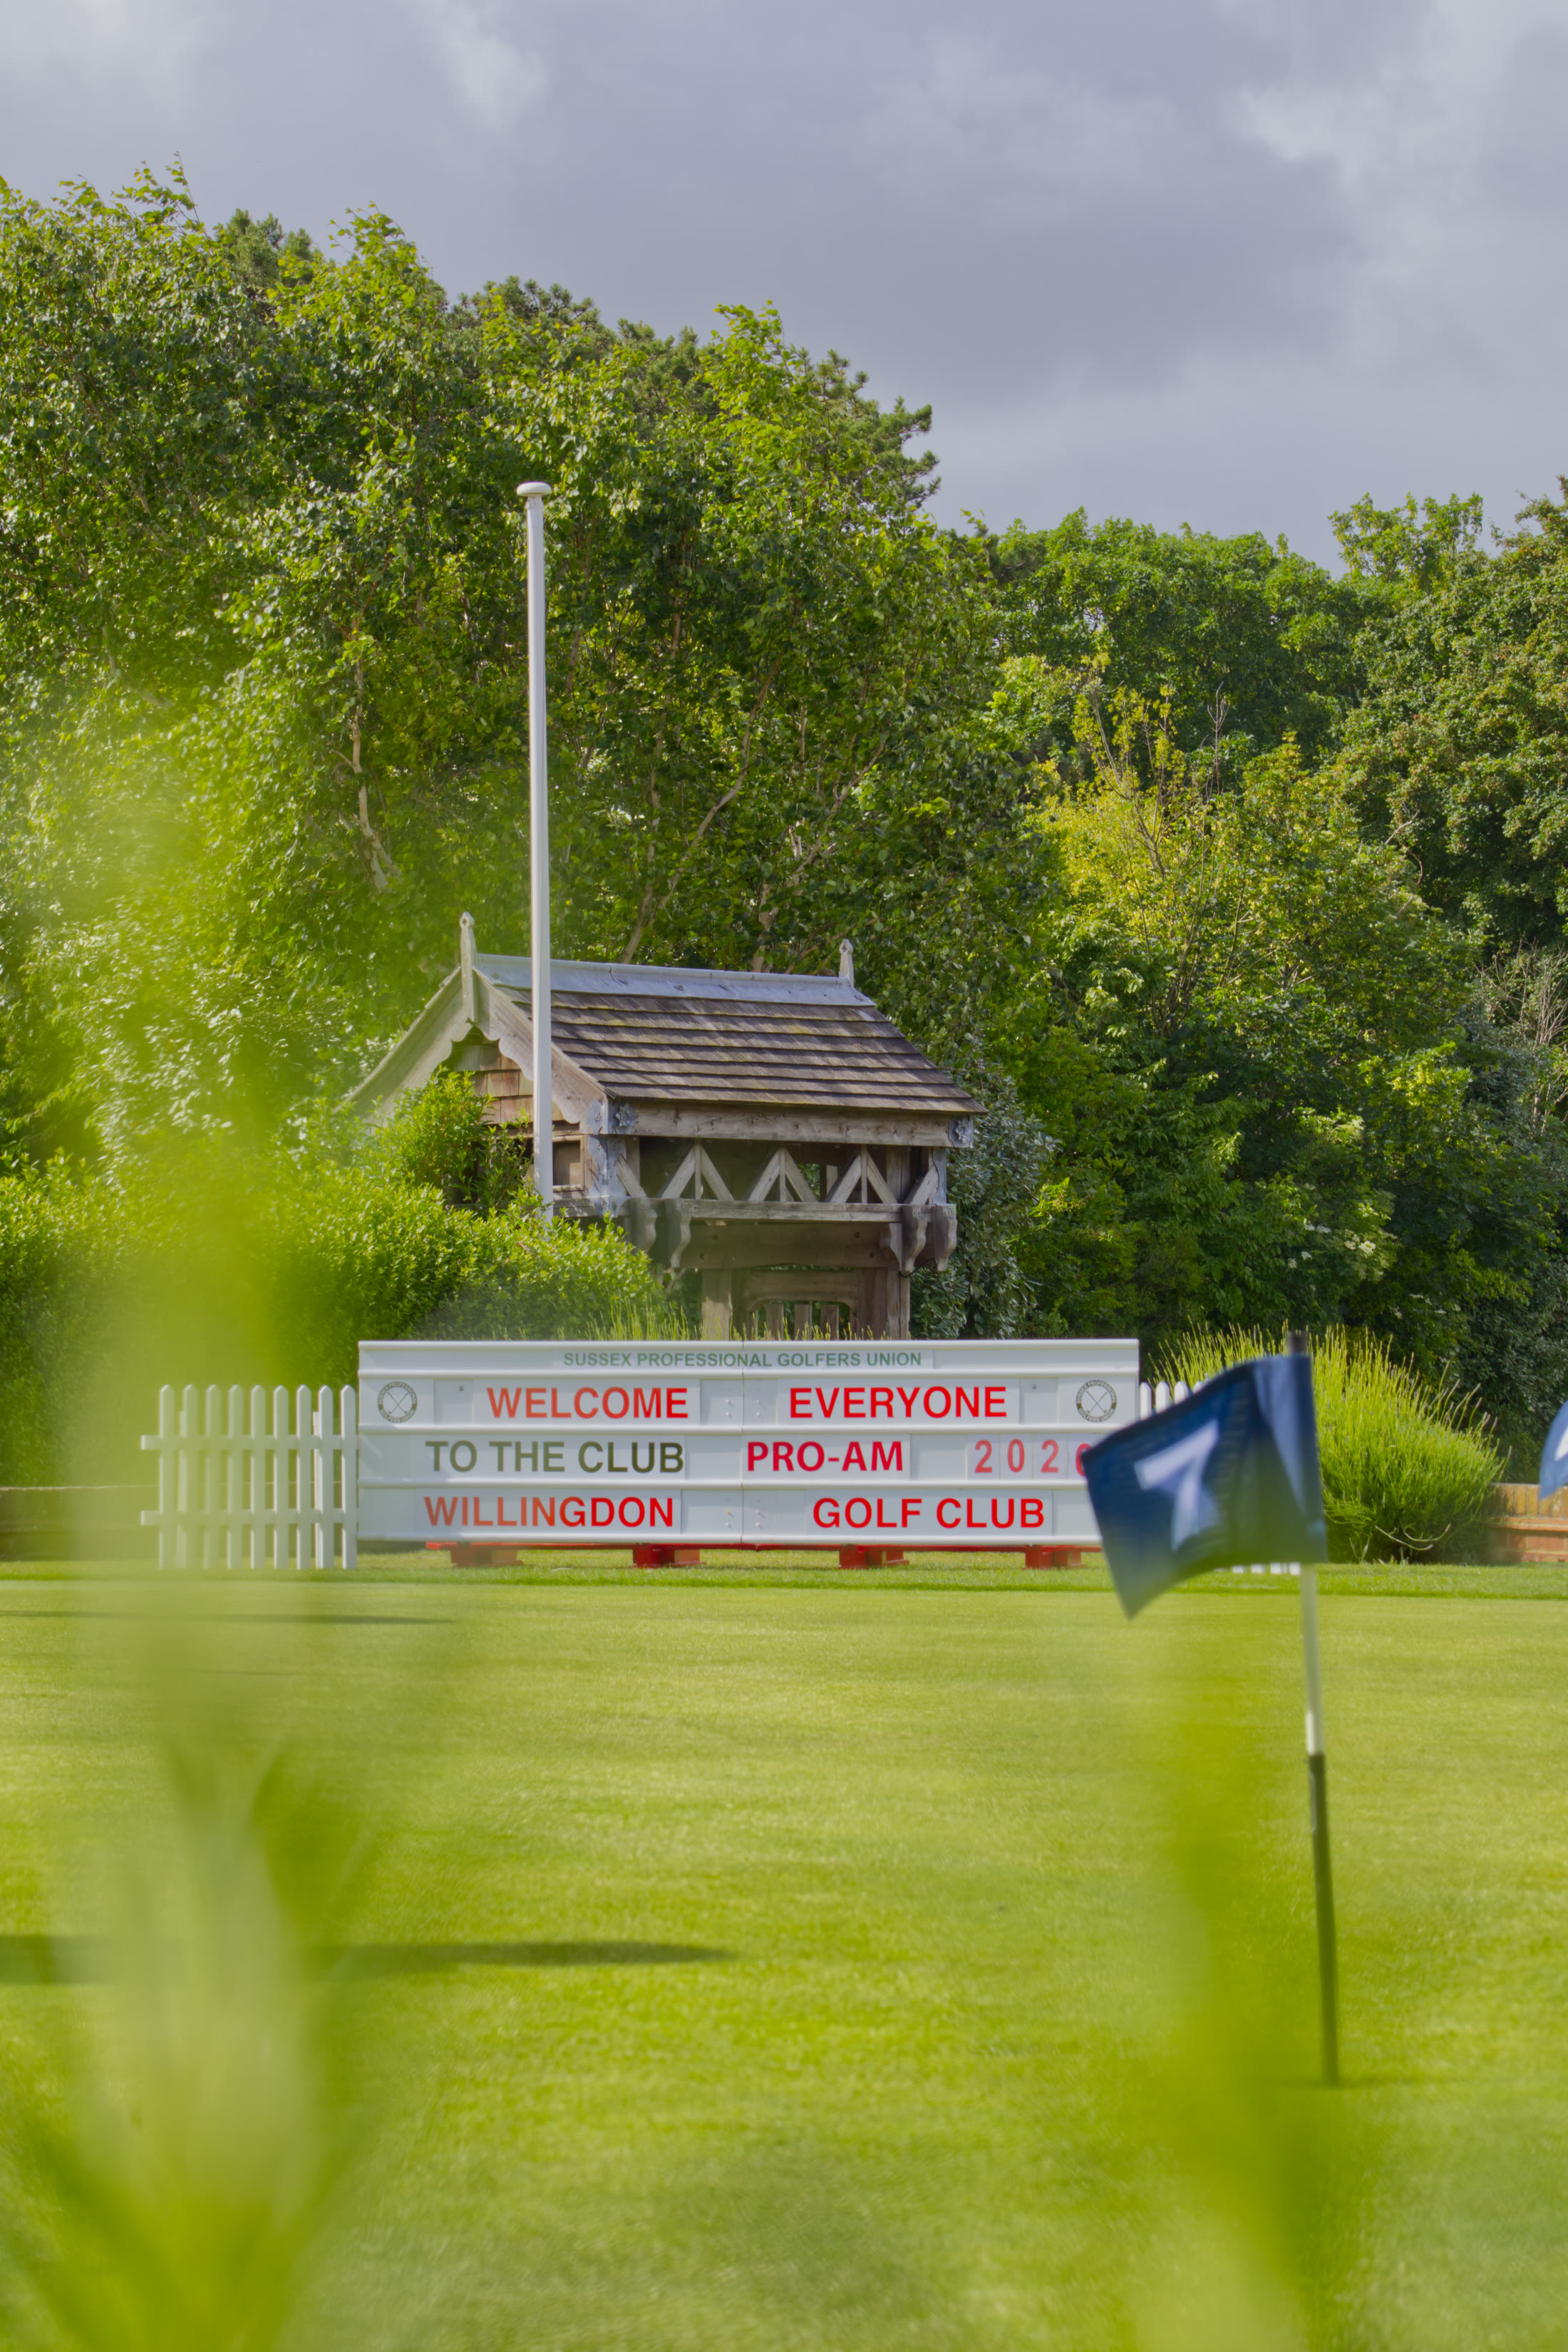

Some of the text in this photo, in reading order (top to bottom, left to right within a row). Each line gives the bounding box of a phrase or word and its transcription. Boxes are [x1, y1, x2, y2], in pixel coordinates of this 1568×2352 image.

[564, 1352, 922, 1367] SUSSEX PROFESSIONAL GOLFERS UNION
[486, 1386, 689, 1420] WELCOME
[789, 1386, 1008, 1419] EVERYONE
[425, 1440, 684, 1473] TO THE CLUB
[746, 1440, 904, 1472] PRO-AM
[423, 1495, 674, 1528] WILLINGDON
[812, 1496, 1046, 1530] GOLF CLUB
